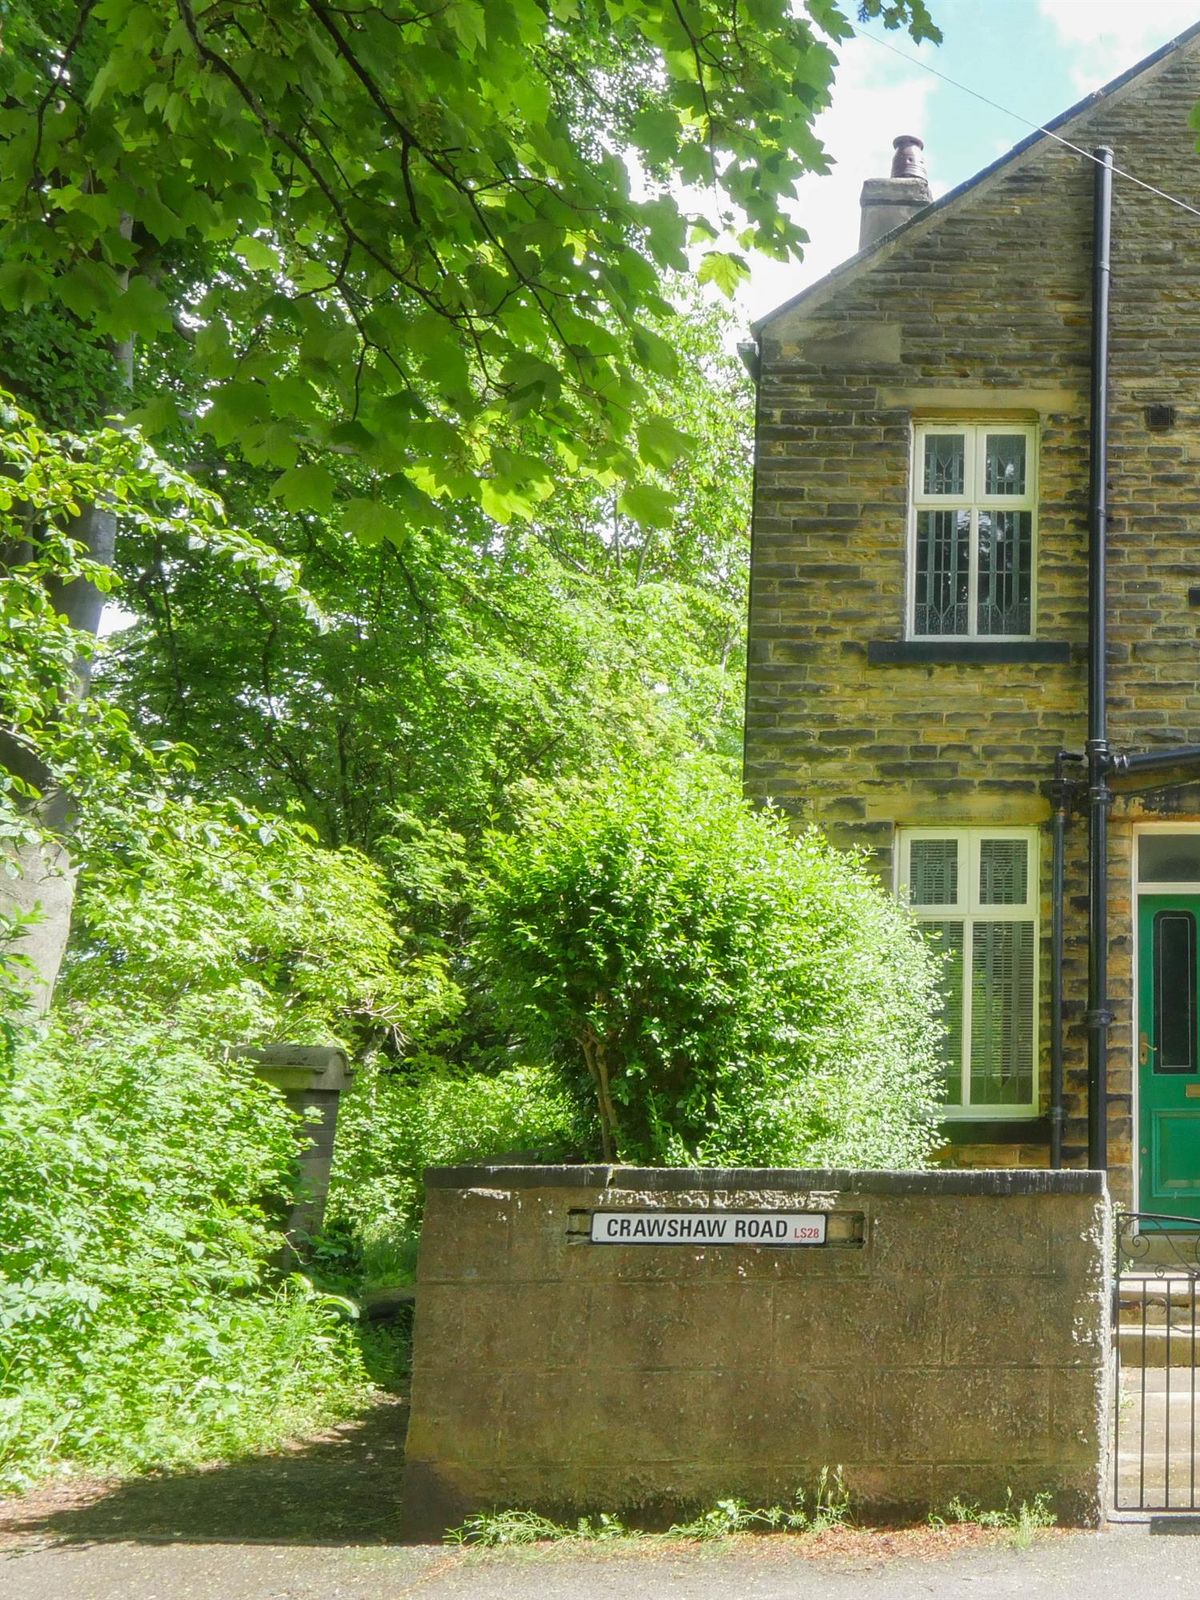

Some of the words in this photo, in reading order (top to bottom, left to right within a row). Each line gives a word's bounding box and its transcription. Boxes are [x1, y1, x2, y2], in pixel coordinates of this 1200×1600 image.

[607, 1219, 727, 1238] CRAWSHAW
[735, 1220, 788, 1238] ROAD
[794, 1227, 820, 1239] LS28
